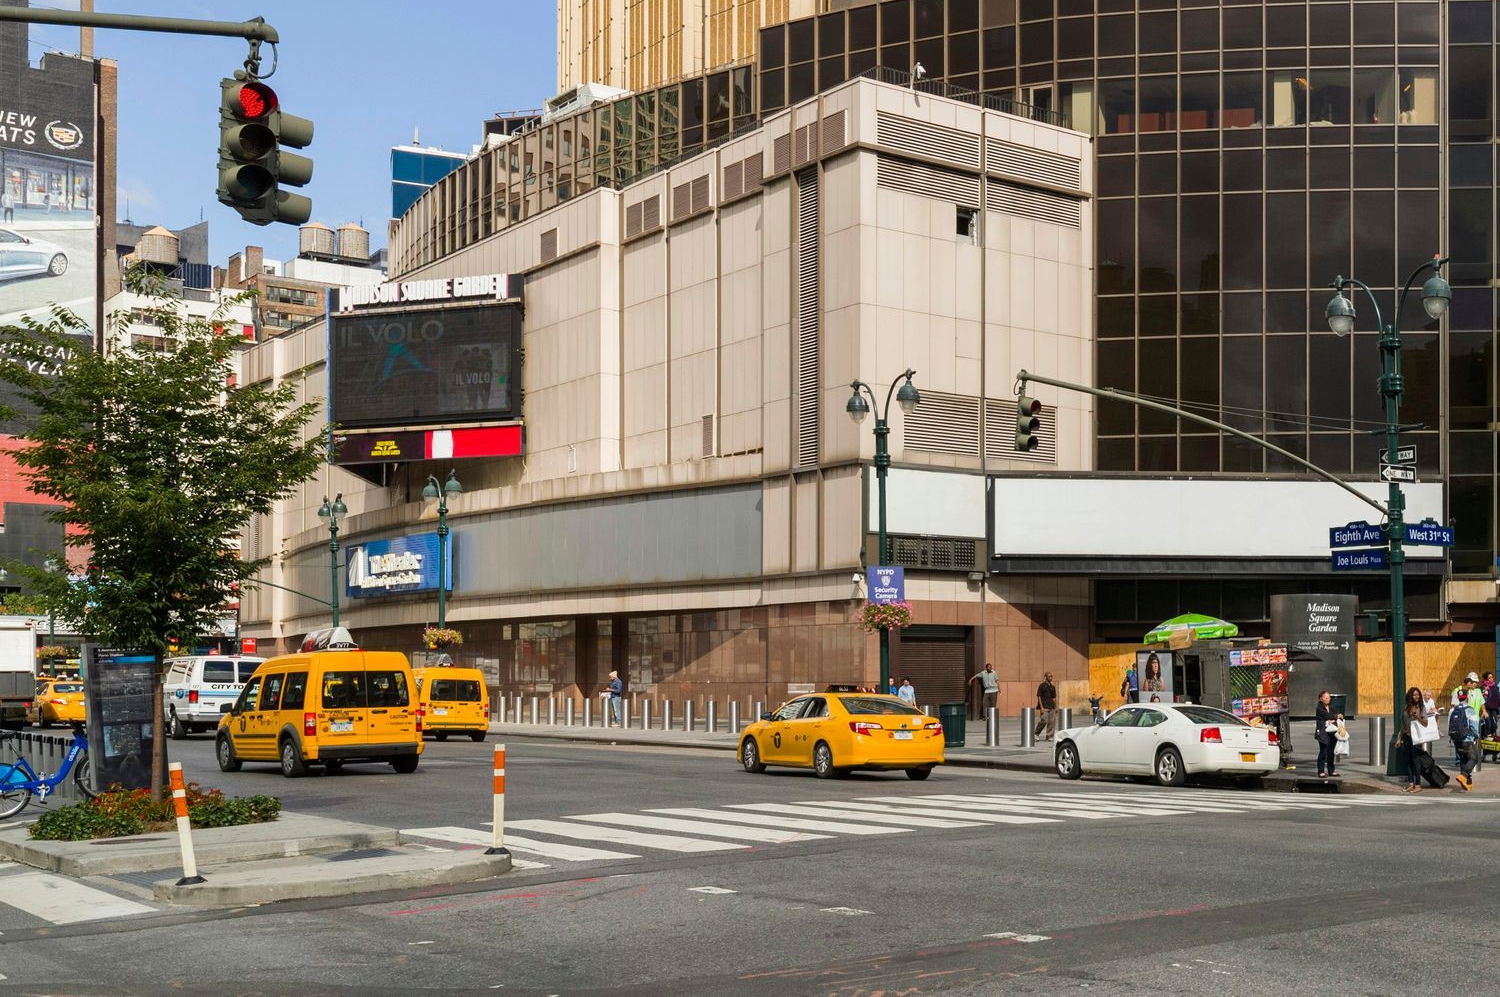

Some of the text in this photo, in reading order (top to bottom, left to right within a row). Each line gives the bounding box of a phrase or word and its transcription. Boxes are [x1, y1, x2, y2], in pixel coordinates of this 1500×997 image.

[339, 273, 509, 313] MADISON SQUARE GARDEN
[341, 320, 444, 347] IL VOLO
[466, 372, 491, 385] VOLO
[1385, 469, 1397, 477] ONE
[1334, 529, 1380, 544] Eighth Ave
[1409, 528, 1428, 541] West
[1442, 531, 1451, 543] St
[1336, 555, 1350, 566] Joe
[1350, 553, 1369, 565] Louis
[874, 586, 899, 594] Security
[1306, 603, 1340, 613] Madison
[1308, 613, 1338, 624] Square
[1308, 623, 1338, 632] Garden
